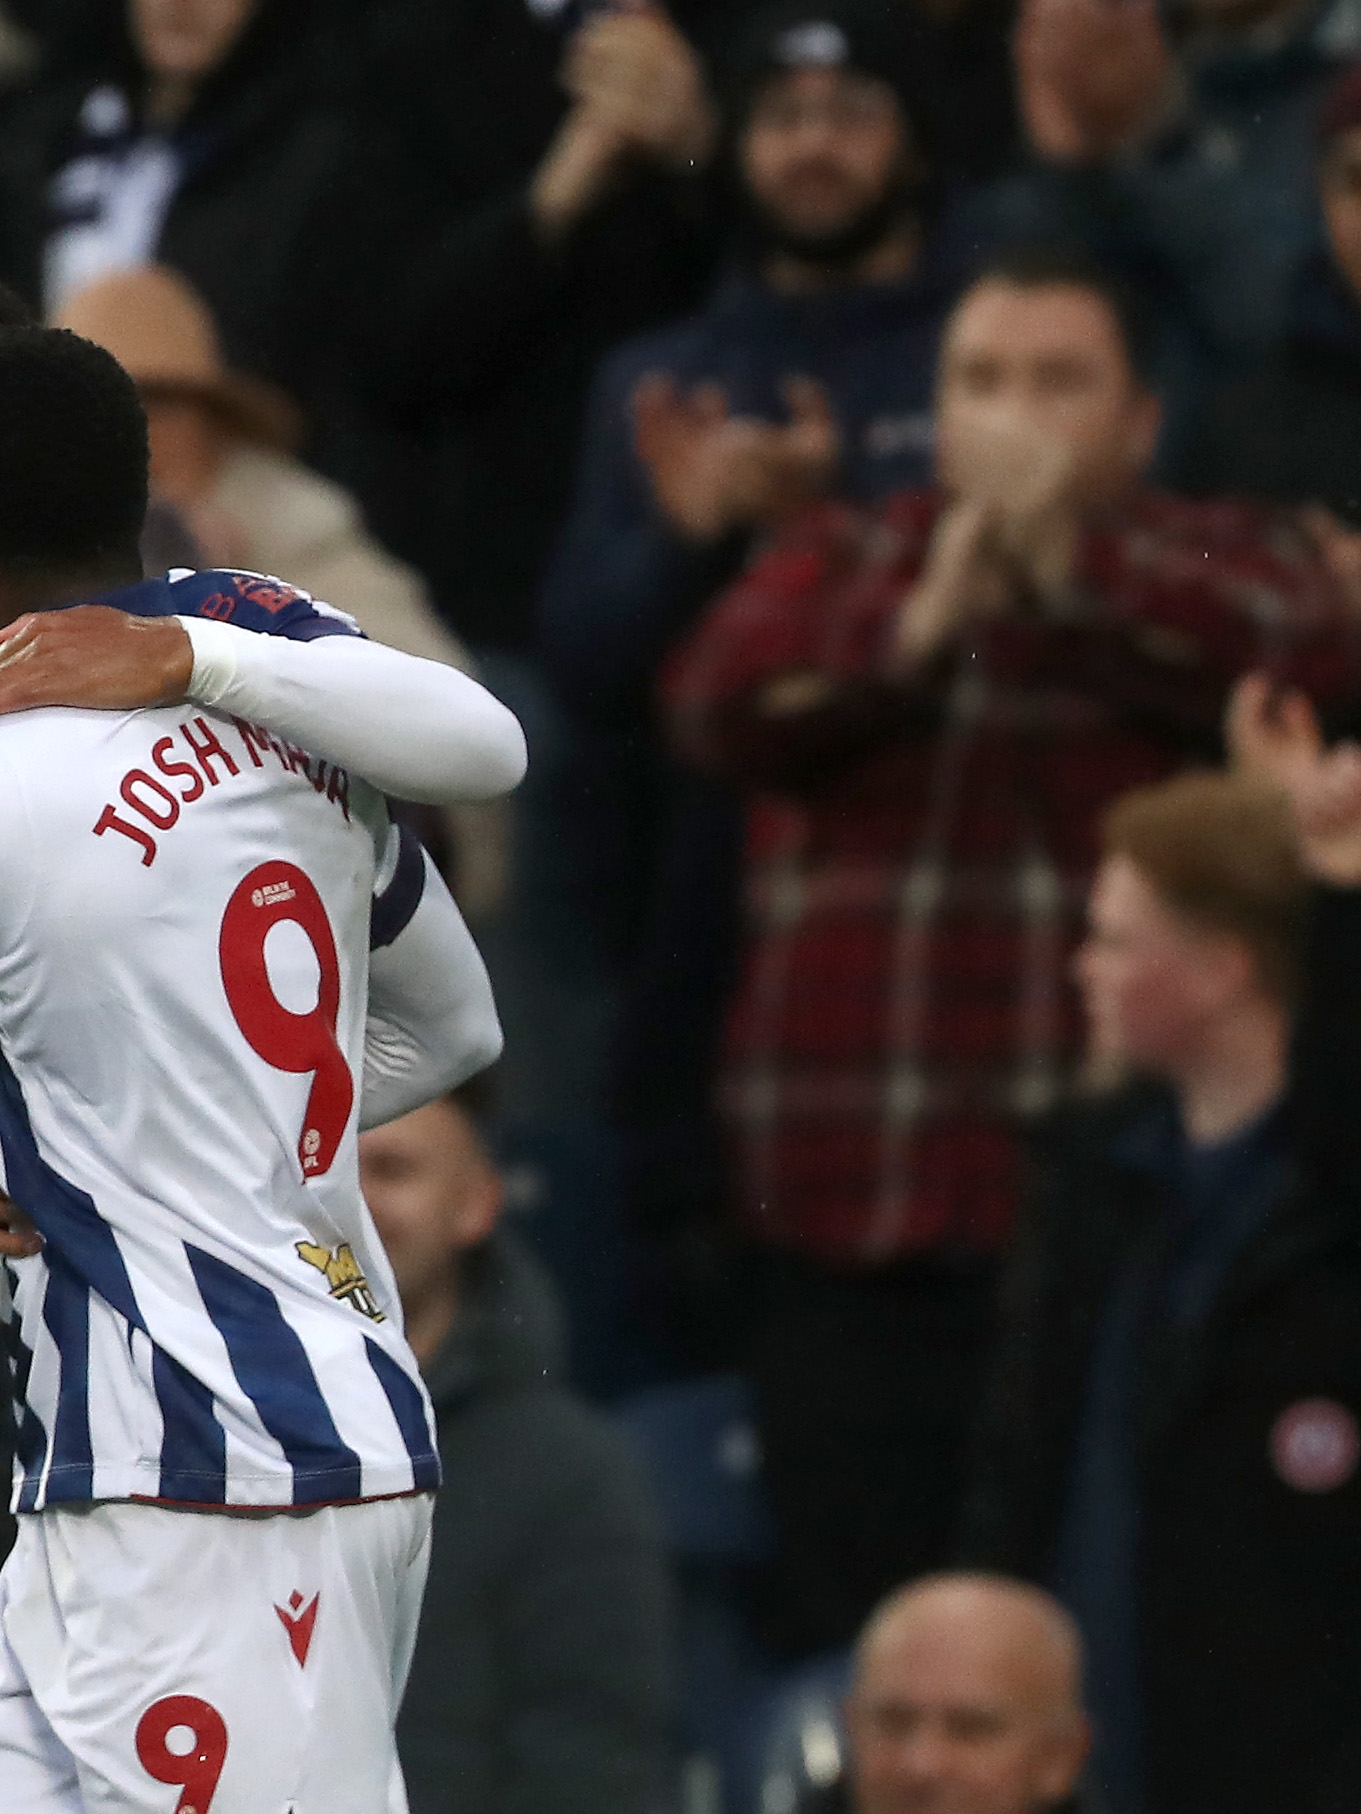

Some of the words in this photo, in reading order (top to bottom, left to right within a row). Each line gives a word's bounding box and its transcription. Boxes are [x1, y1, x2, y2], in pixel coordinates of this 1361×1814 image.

[92, 715, 241, 867] JOSH
[218, 859, 355, 1178] 9
[135, 1694, 229, 1814] 9
